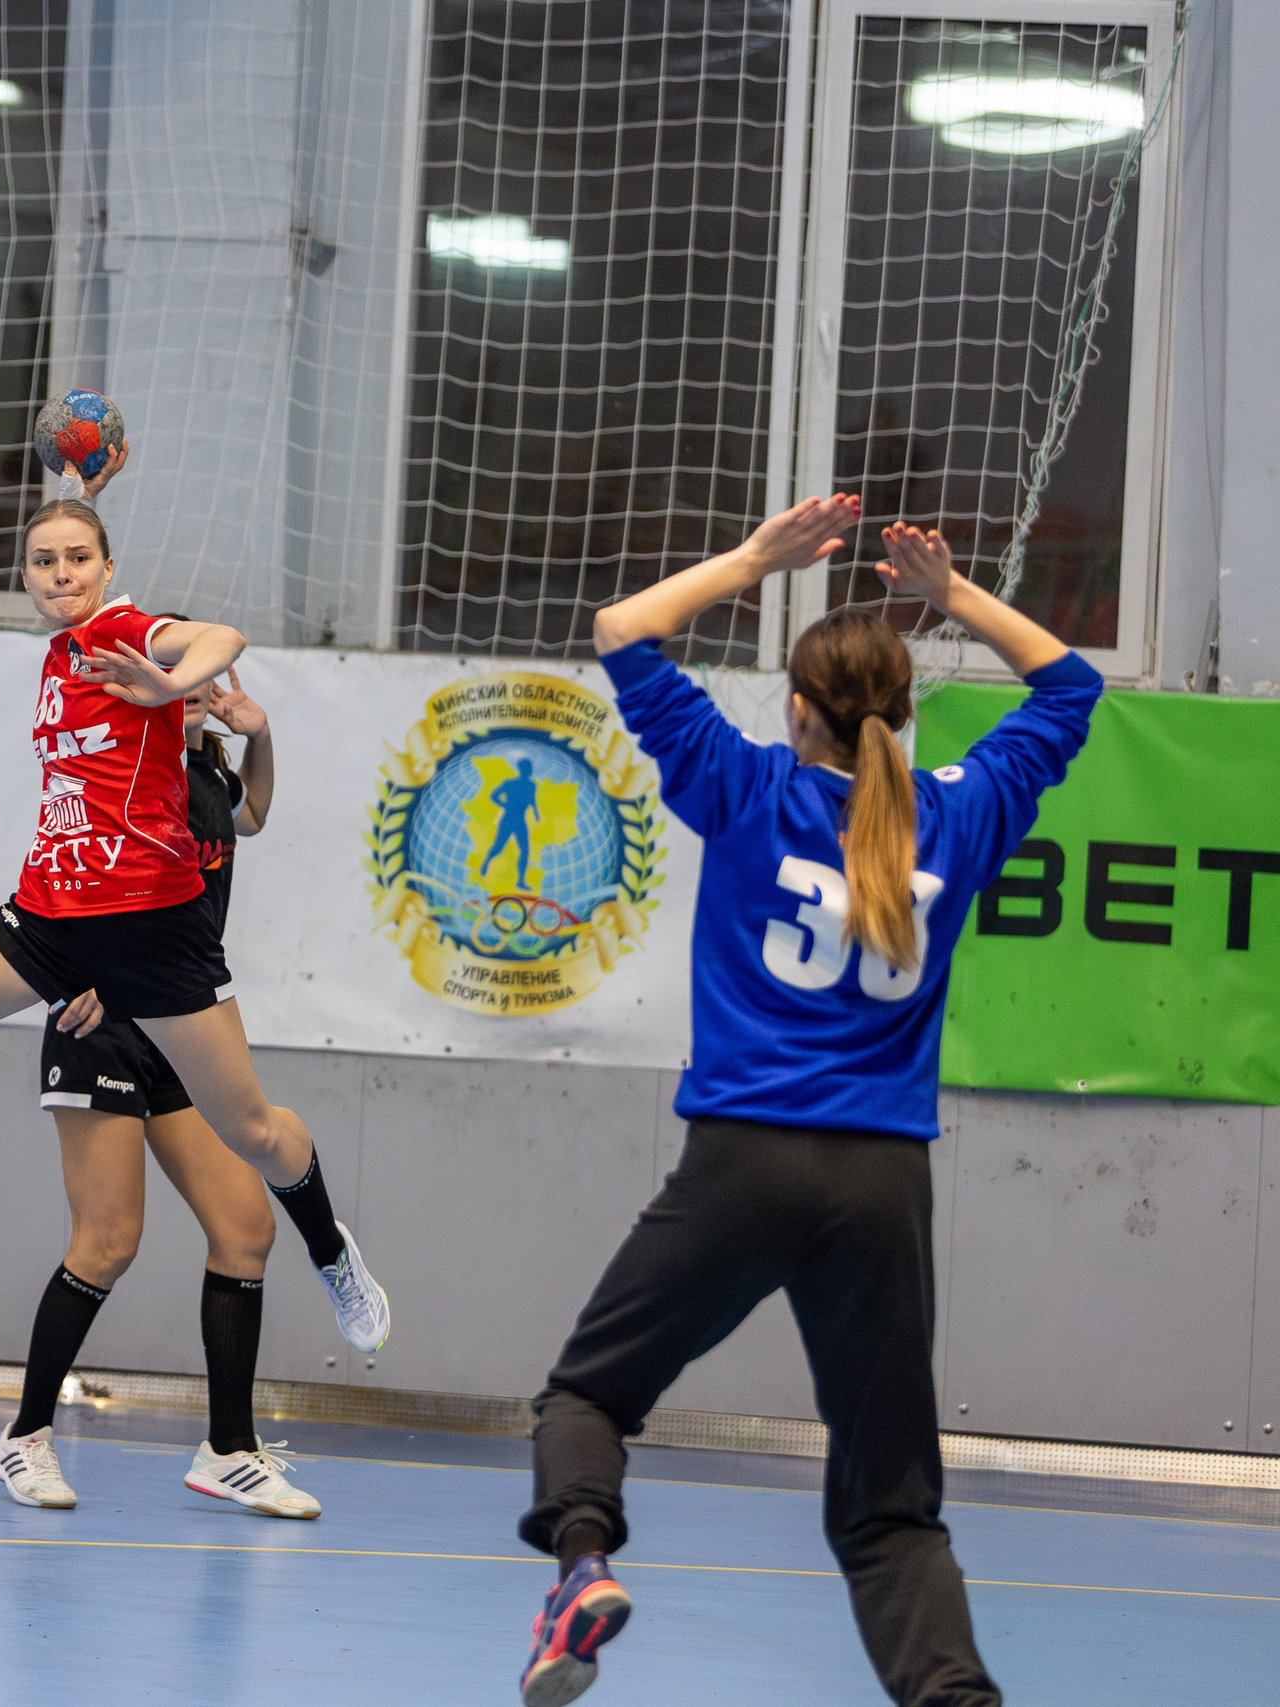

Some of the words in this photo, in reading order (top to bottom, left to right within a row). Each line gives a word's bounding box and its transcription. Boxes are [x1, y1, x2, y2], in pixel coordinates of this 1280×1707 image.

[432, 681, 508, 715] МИНСКИЙ
[511, 683, 608, 723] ОБЛАСТНОЙ
[436, 703, 547, 731] ИСПОЛНИТЕЛЬНЫЙ
[549, 709, 603, 737] КОМИТЕТ
[53, 880, 82, 891] 920
[461, 963, 562, 987] УПРАВЛЕНИЕ
[443, 979, 496, 1006] СПОРТА
[513, 985, 576, 1007] ТУРИЗМА
[96, 1074, 135, 1094] Kempa
[62, 1271, 109, 1300] Kemp
